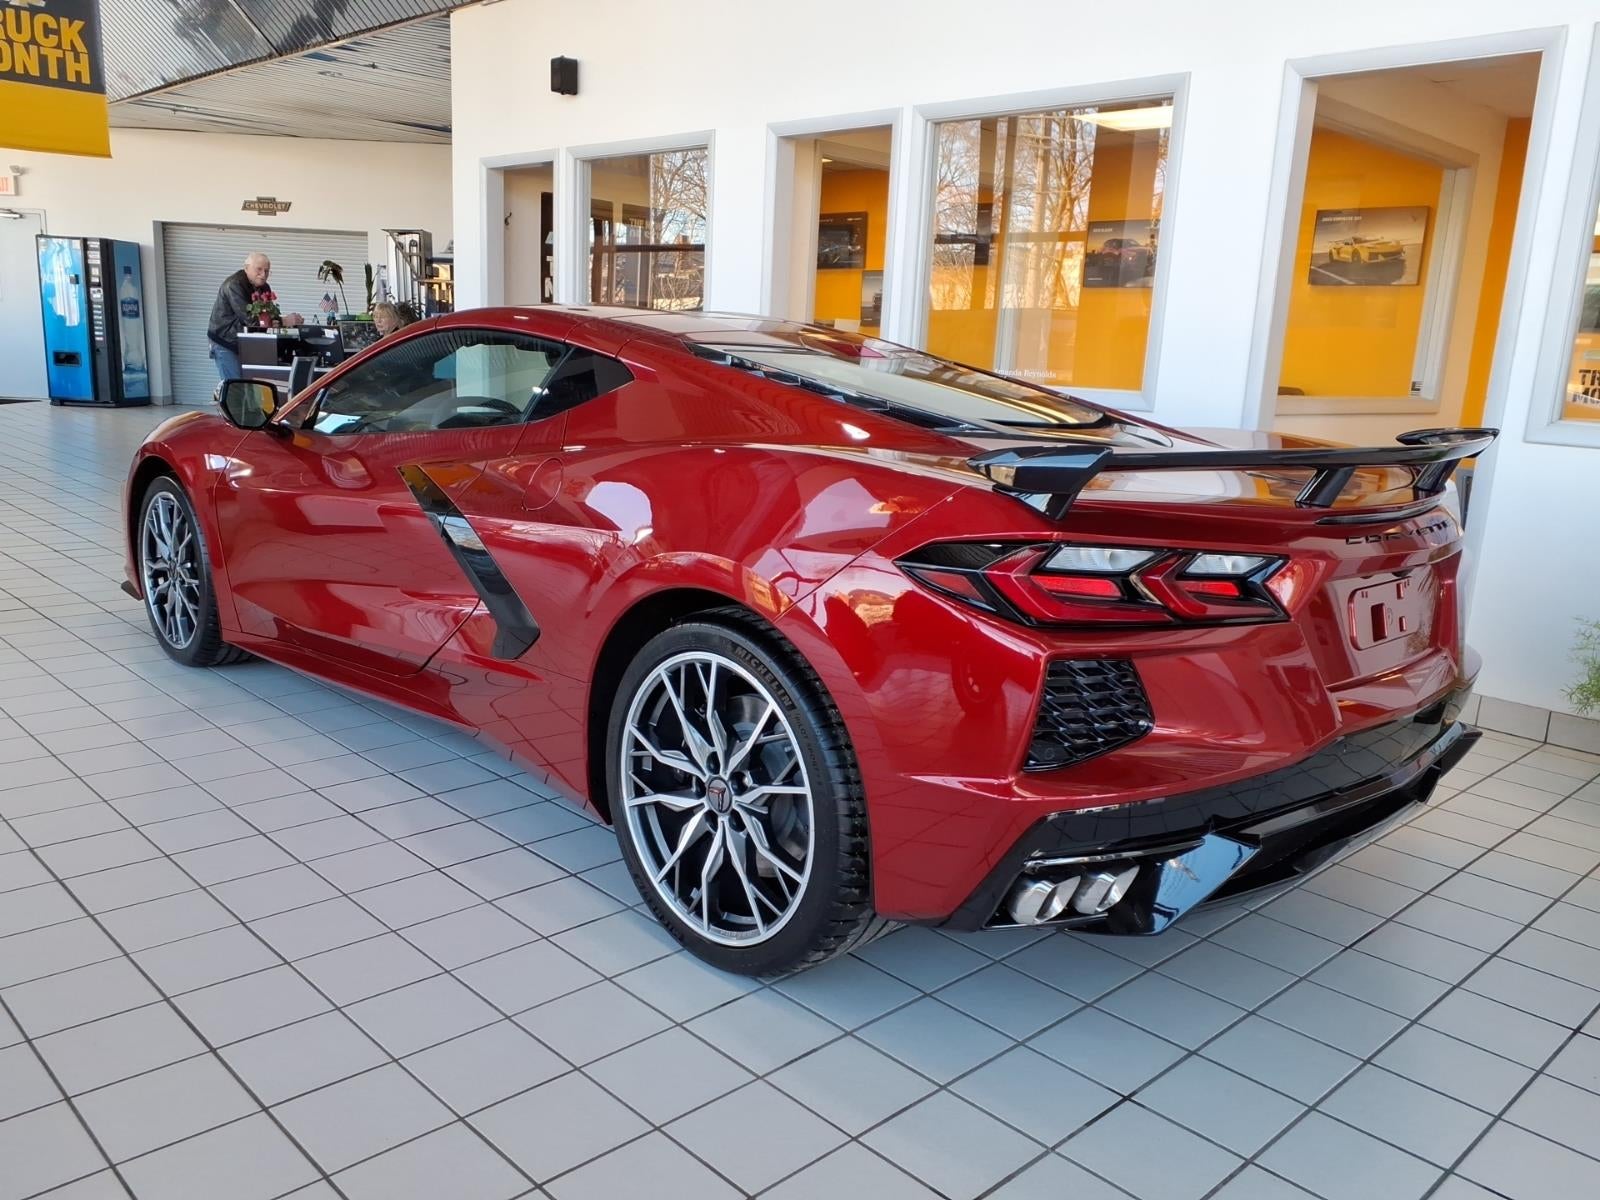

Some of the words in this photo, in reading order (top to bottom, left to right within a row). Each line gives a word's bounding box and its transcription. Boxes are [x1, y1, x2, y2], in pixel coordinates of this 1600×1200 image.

[0, 8, 88, 53] UCK
[245, 202, 286, 210] CHEVROLET
[735, 646, 793, 707] MICHELIN
